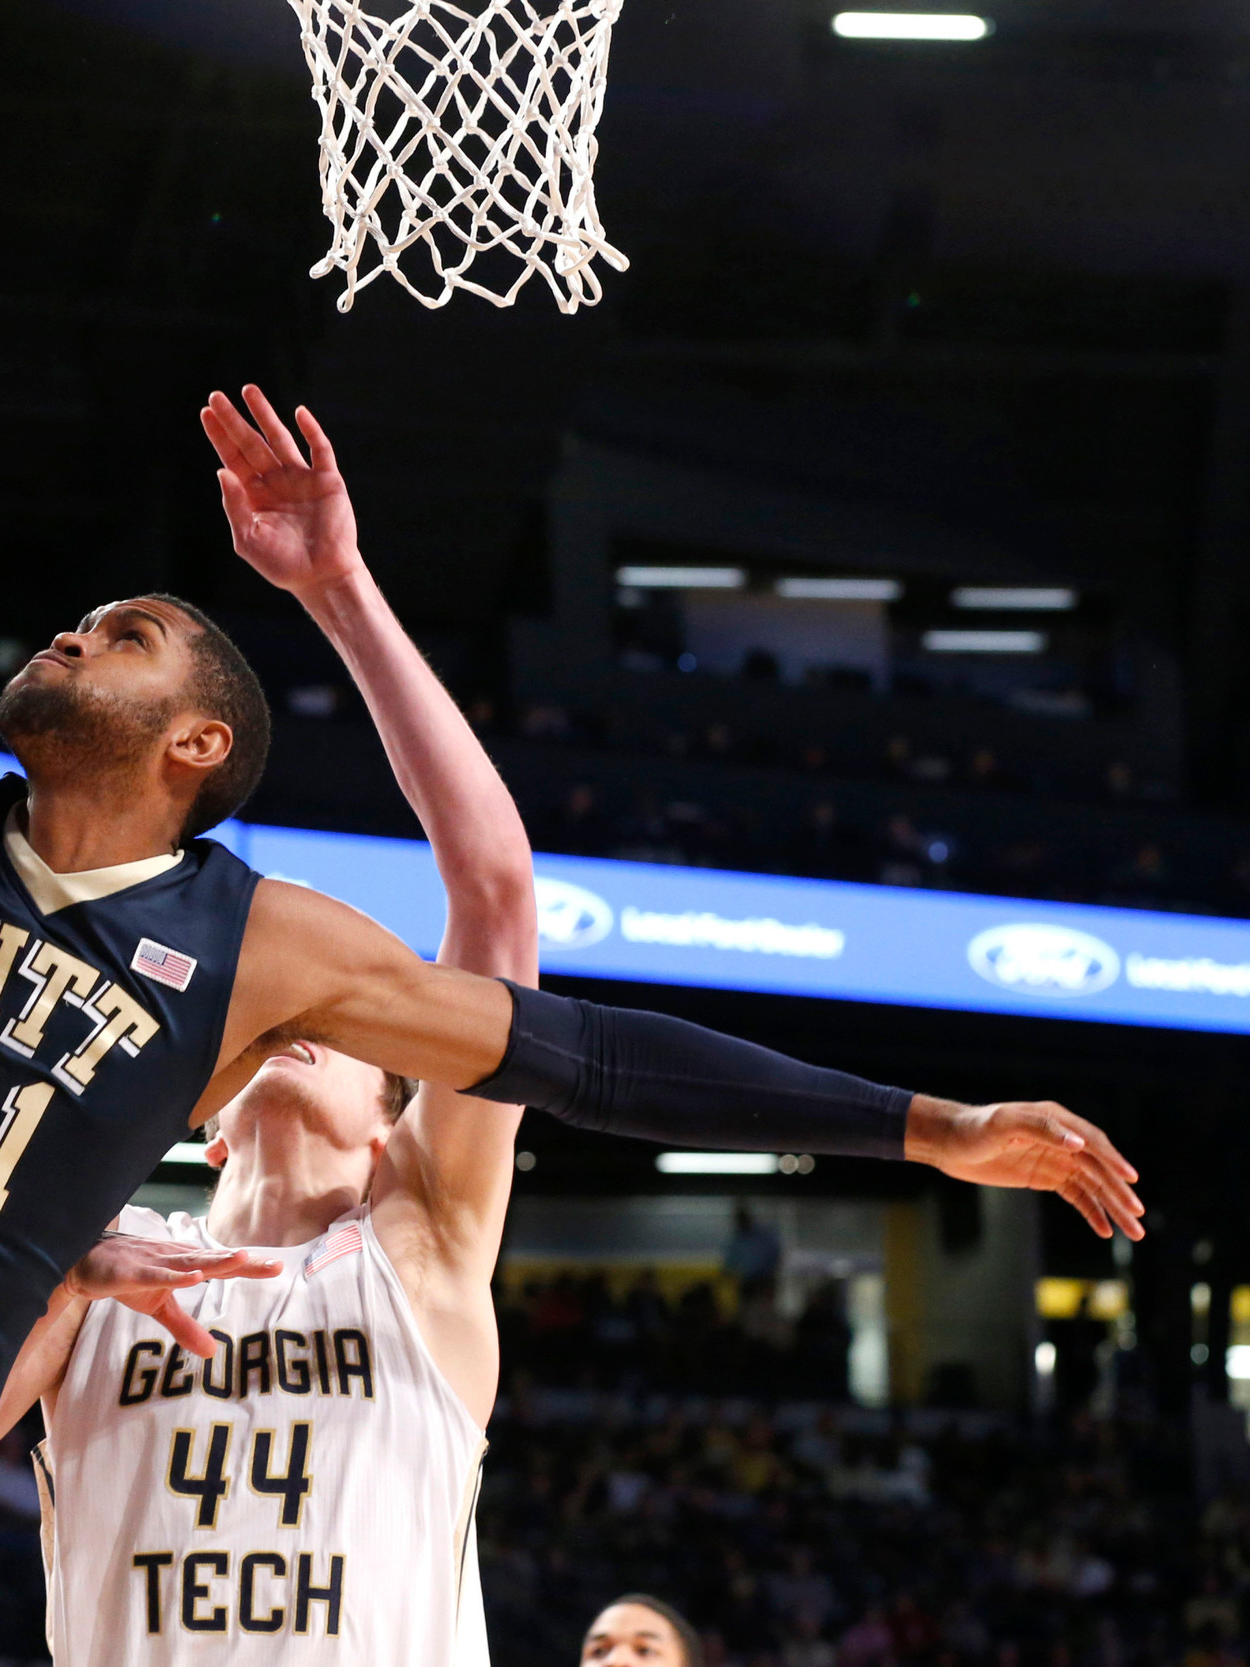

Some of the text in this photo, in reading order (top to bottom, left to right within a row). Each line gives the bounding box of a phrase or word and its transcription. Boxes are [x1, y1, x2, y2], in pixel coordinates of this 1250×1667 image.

[118, 1327, 376, 1408] GEORGIA
[164, 1419, 314, 1531] 44
[131, 1550, 347, 1639] TECH
